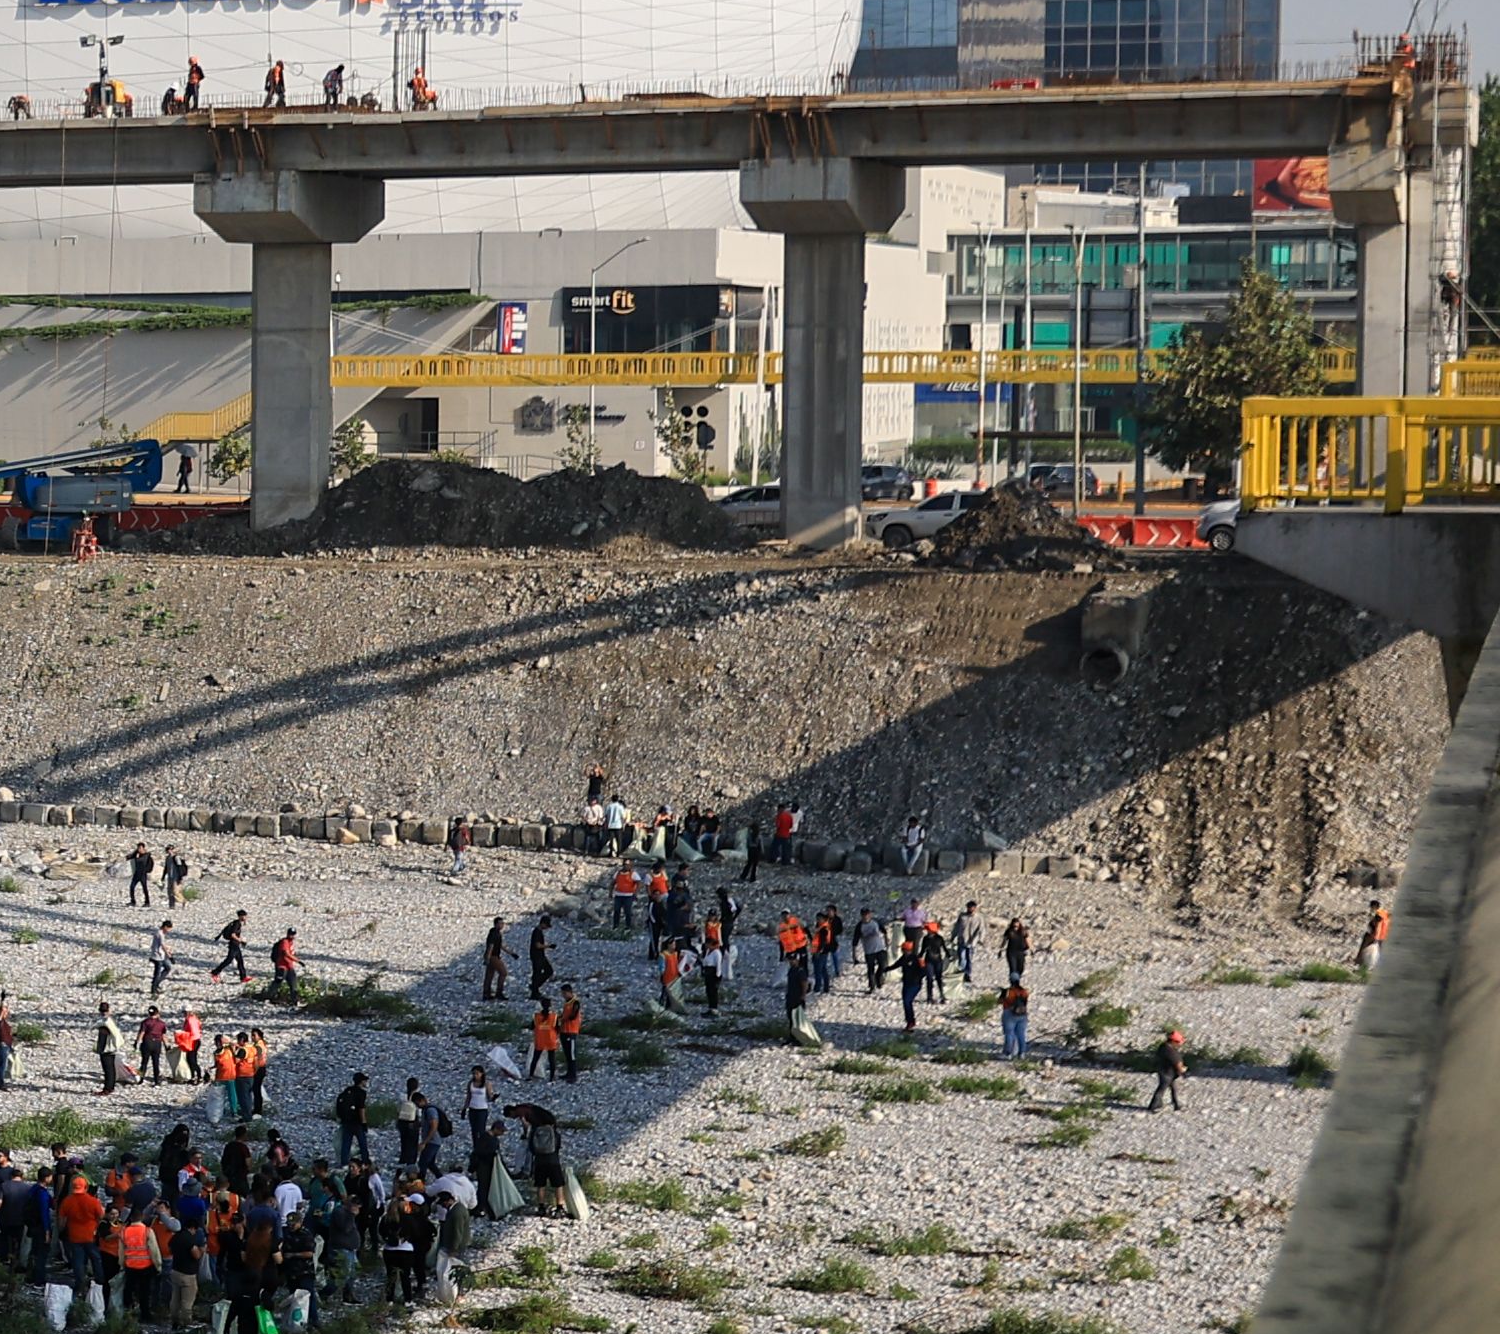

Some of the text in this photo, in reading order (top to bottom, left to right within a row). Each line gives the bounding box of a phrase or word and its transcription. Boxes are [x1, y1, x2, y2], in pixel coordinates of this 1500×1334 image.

[399, 9, 519, 23] SEGUROS
[571, 290, 636, 308] smart fit
